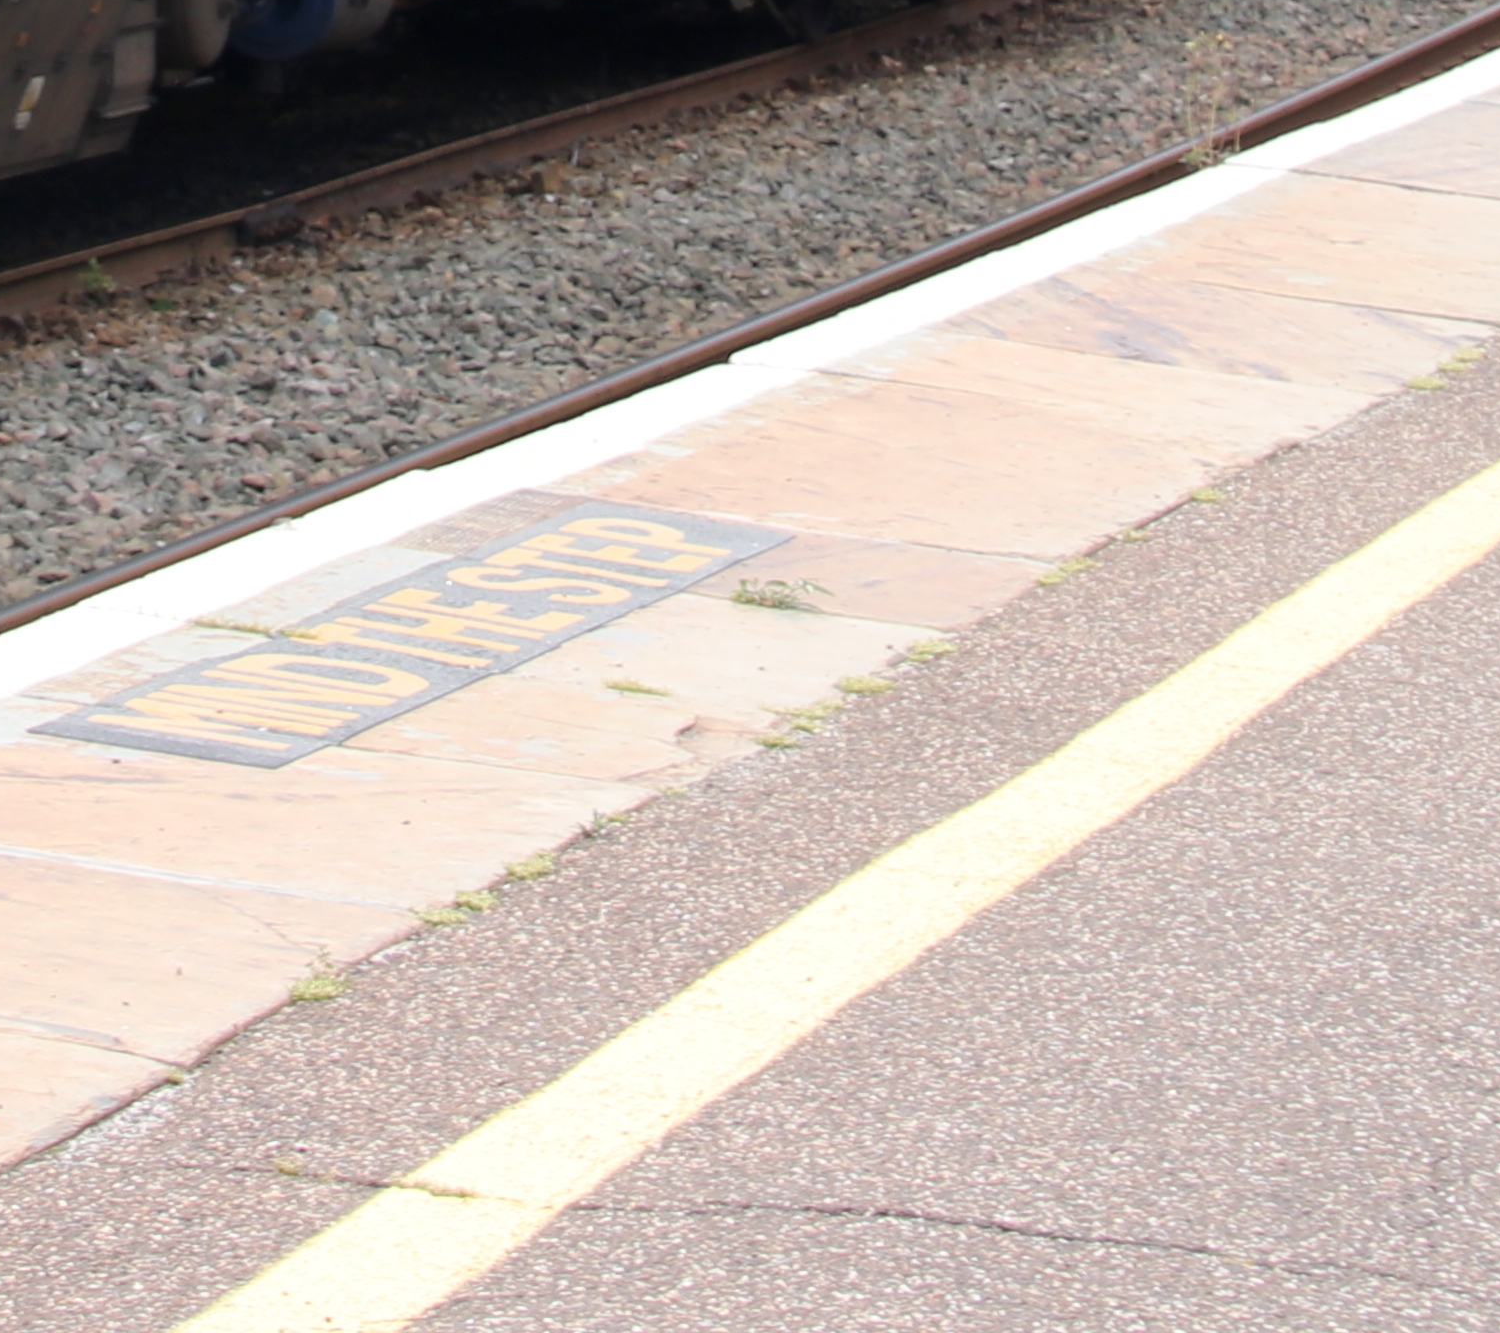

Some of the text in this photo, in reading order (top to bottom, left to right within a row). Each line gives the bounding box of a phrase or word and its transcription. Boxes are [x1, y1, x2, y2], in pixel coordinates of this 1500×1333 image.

[85, 516, 734, 751] MIND THE STEP
